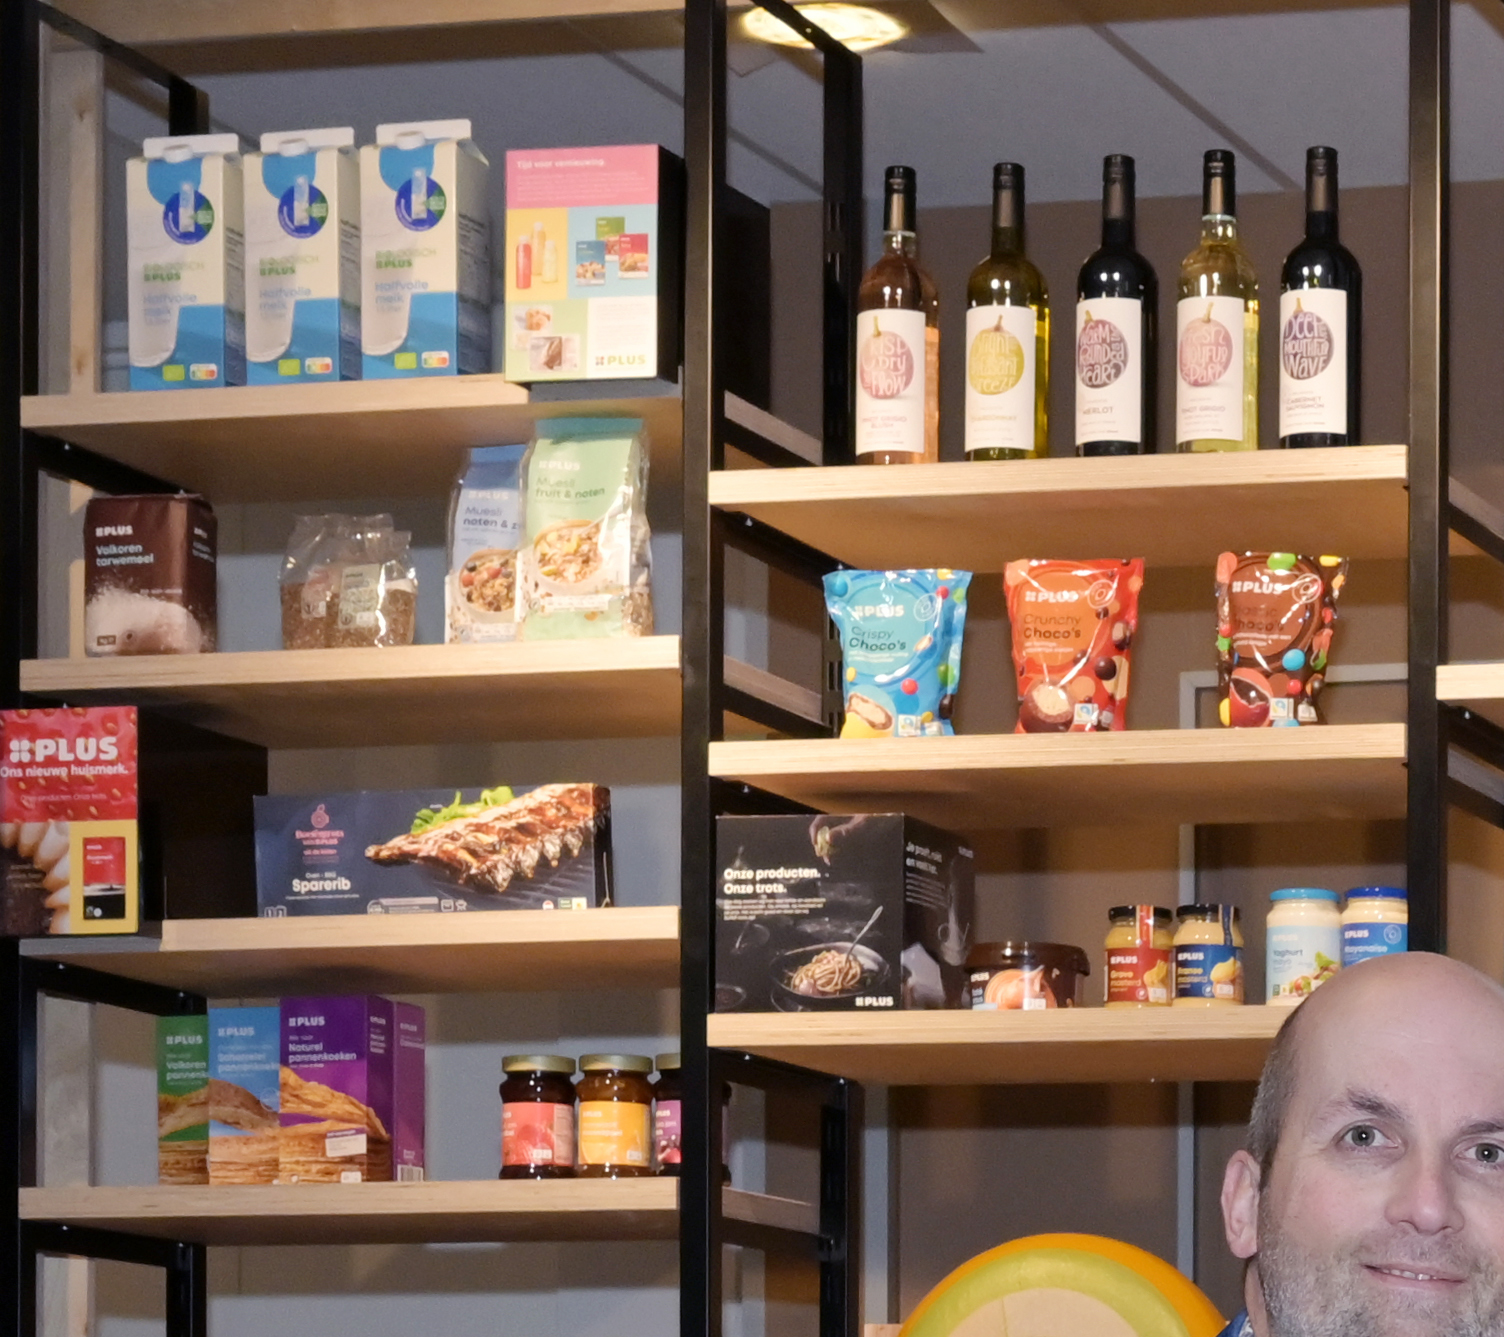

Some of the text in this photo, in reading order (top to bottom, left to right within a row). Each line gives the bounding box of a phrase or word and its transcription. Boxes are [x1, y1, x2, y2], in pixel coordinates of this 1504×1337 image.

[535, 487, 605, 498] fruit noten
[463, 517, 497, 528] noten
[1023, 613, 1082, 626] Crunchy
[851, 626, 894, 640] Crispy
[1023, 625, 1081, 639] Choco's
[849, 638, 906, 652] Choco's
[35, 736, 118, 761] PLUS
[0, 766, 23, 777] Ons
[26, 765, 68, 776] nieuwe
[723, 867, 821, 882] Onze producten.
[292, 877, 351, 893] Sparerib
[723, 883, 787, 894] Onze trots.
[865, 996, 894, 1007] PLUS
